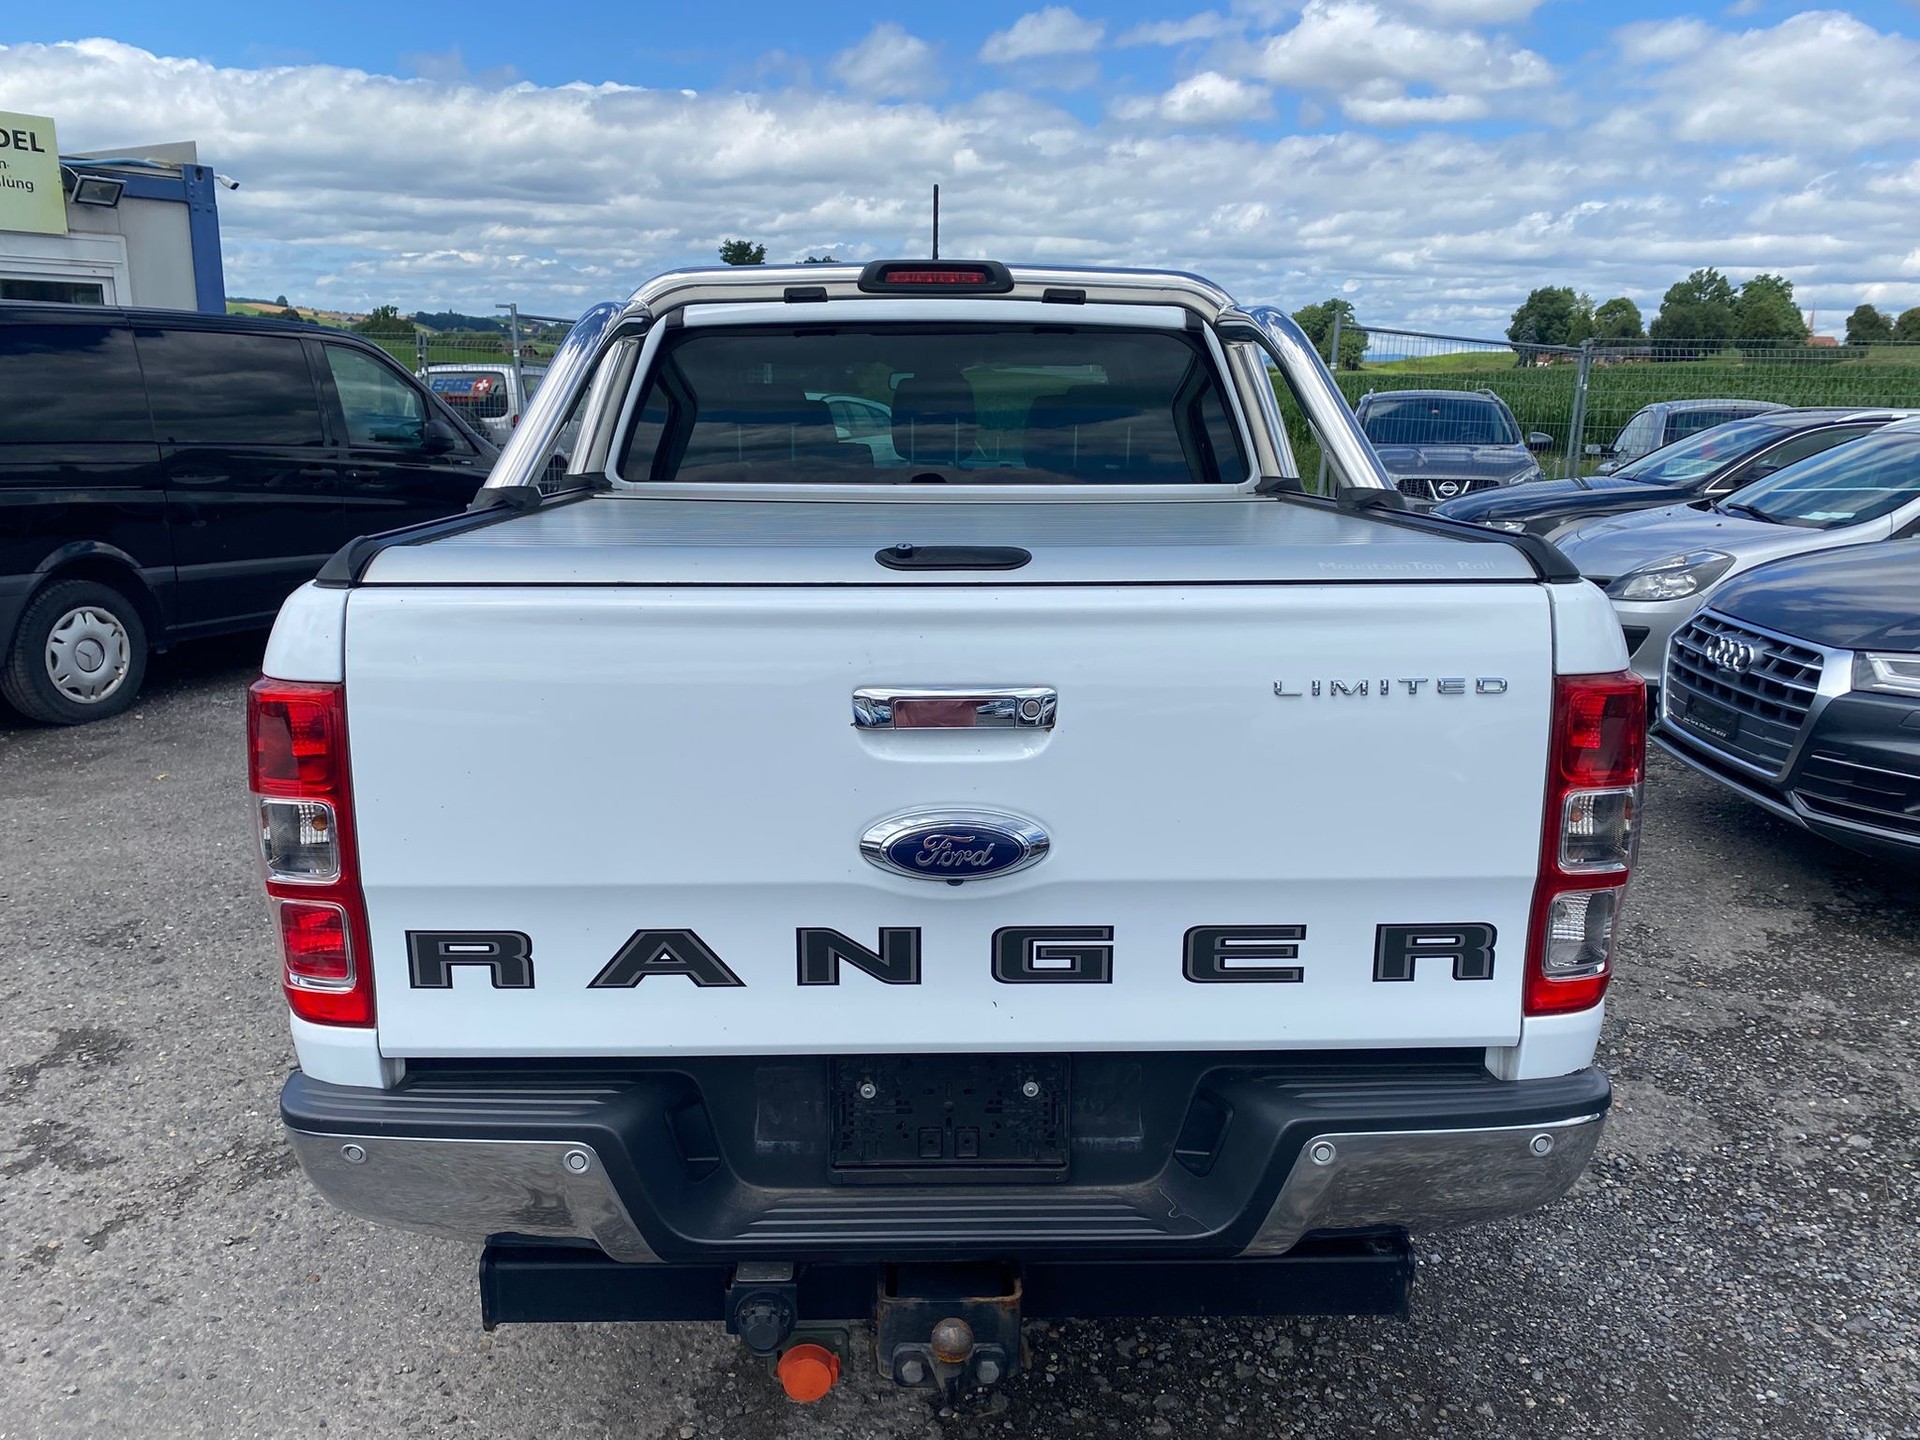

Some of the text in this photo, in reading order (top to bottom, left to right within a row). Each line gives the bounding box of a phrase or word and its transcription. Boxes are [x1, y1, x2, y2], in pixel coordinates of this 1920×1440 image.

[0, 175, 34, 193] lung
[1317, 561, 1446, 572] MountainTop
[1273, 676, 1508, 697] LIMITED
[915, 834, 995, 867] Ford
[406, 922, 1497, 989] RANGER
